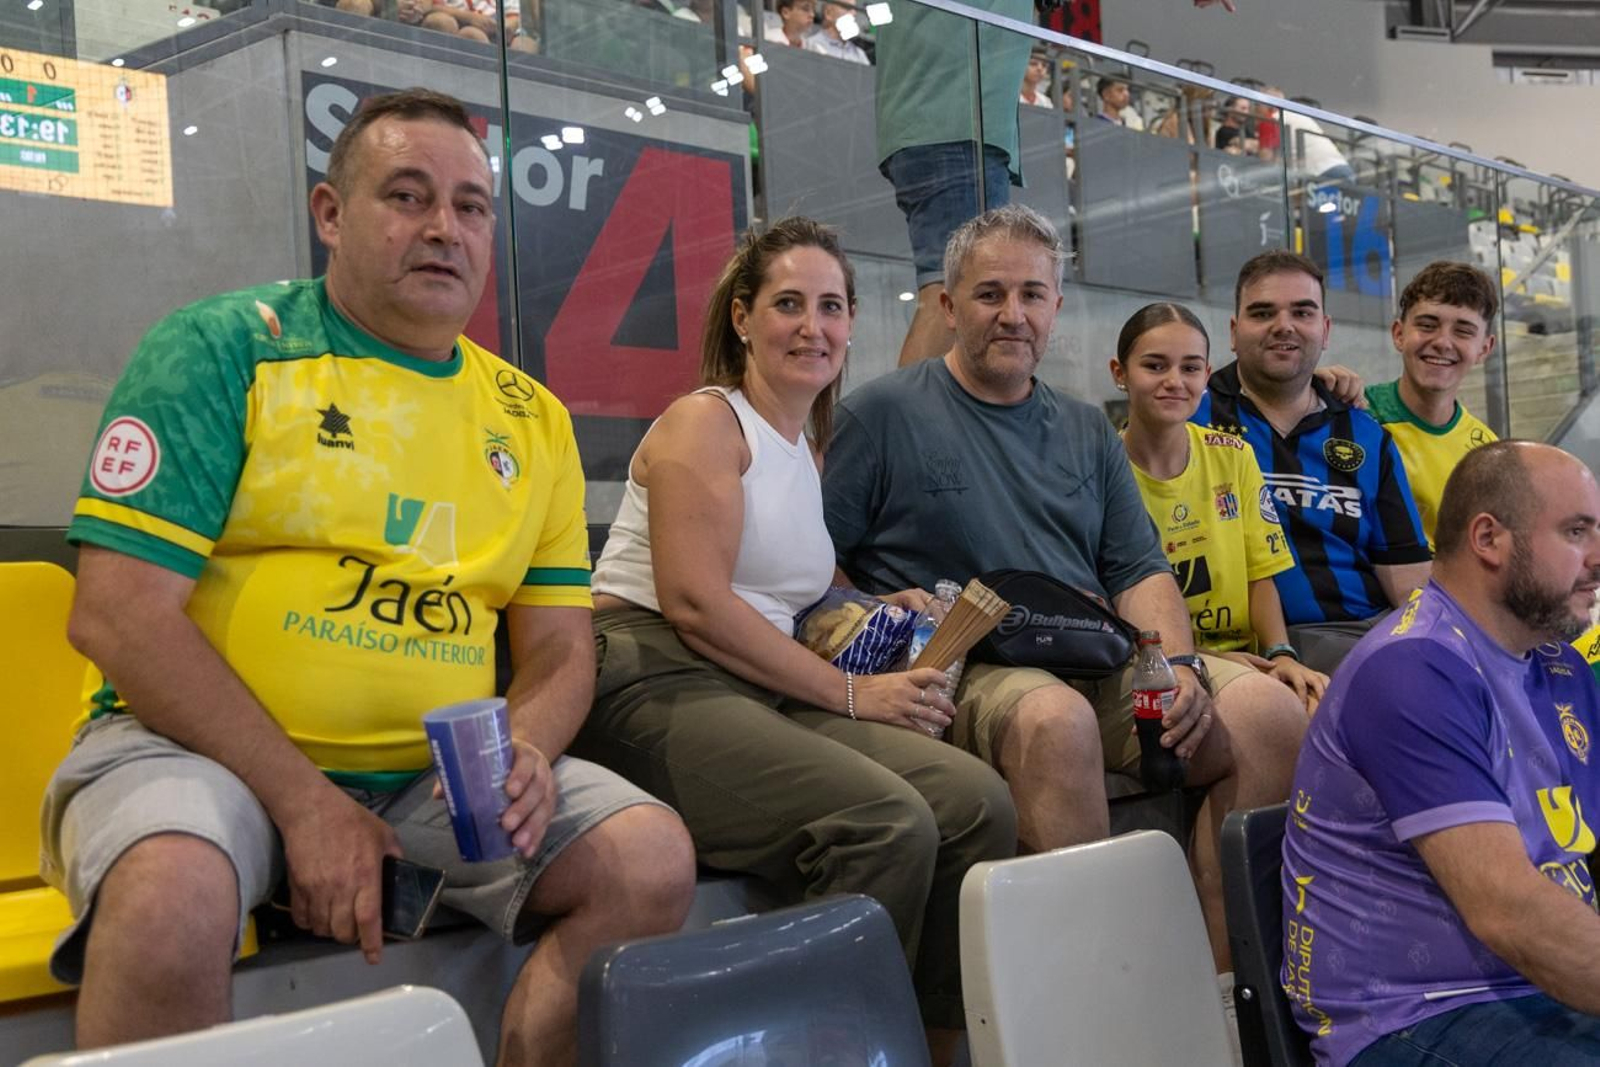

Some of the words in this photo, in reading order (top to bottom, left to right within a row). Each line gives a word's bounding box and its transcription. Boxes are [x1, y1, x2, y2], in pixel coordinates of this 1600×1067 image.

[305, 83, 604, 211] Sor
[458, 115, 738, 420] 4
[1273, 487, 1363, 518] ATAS
[324, 555, 472, 636] Jaén
[1029, 613, 1101, 630] Bullpadel
[1196, 599, 1231, 631] én
[283, 611, 399, 654] PARAÍSO
[404, 637, 485, 666] INTERIOR
